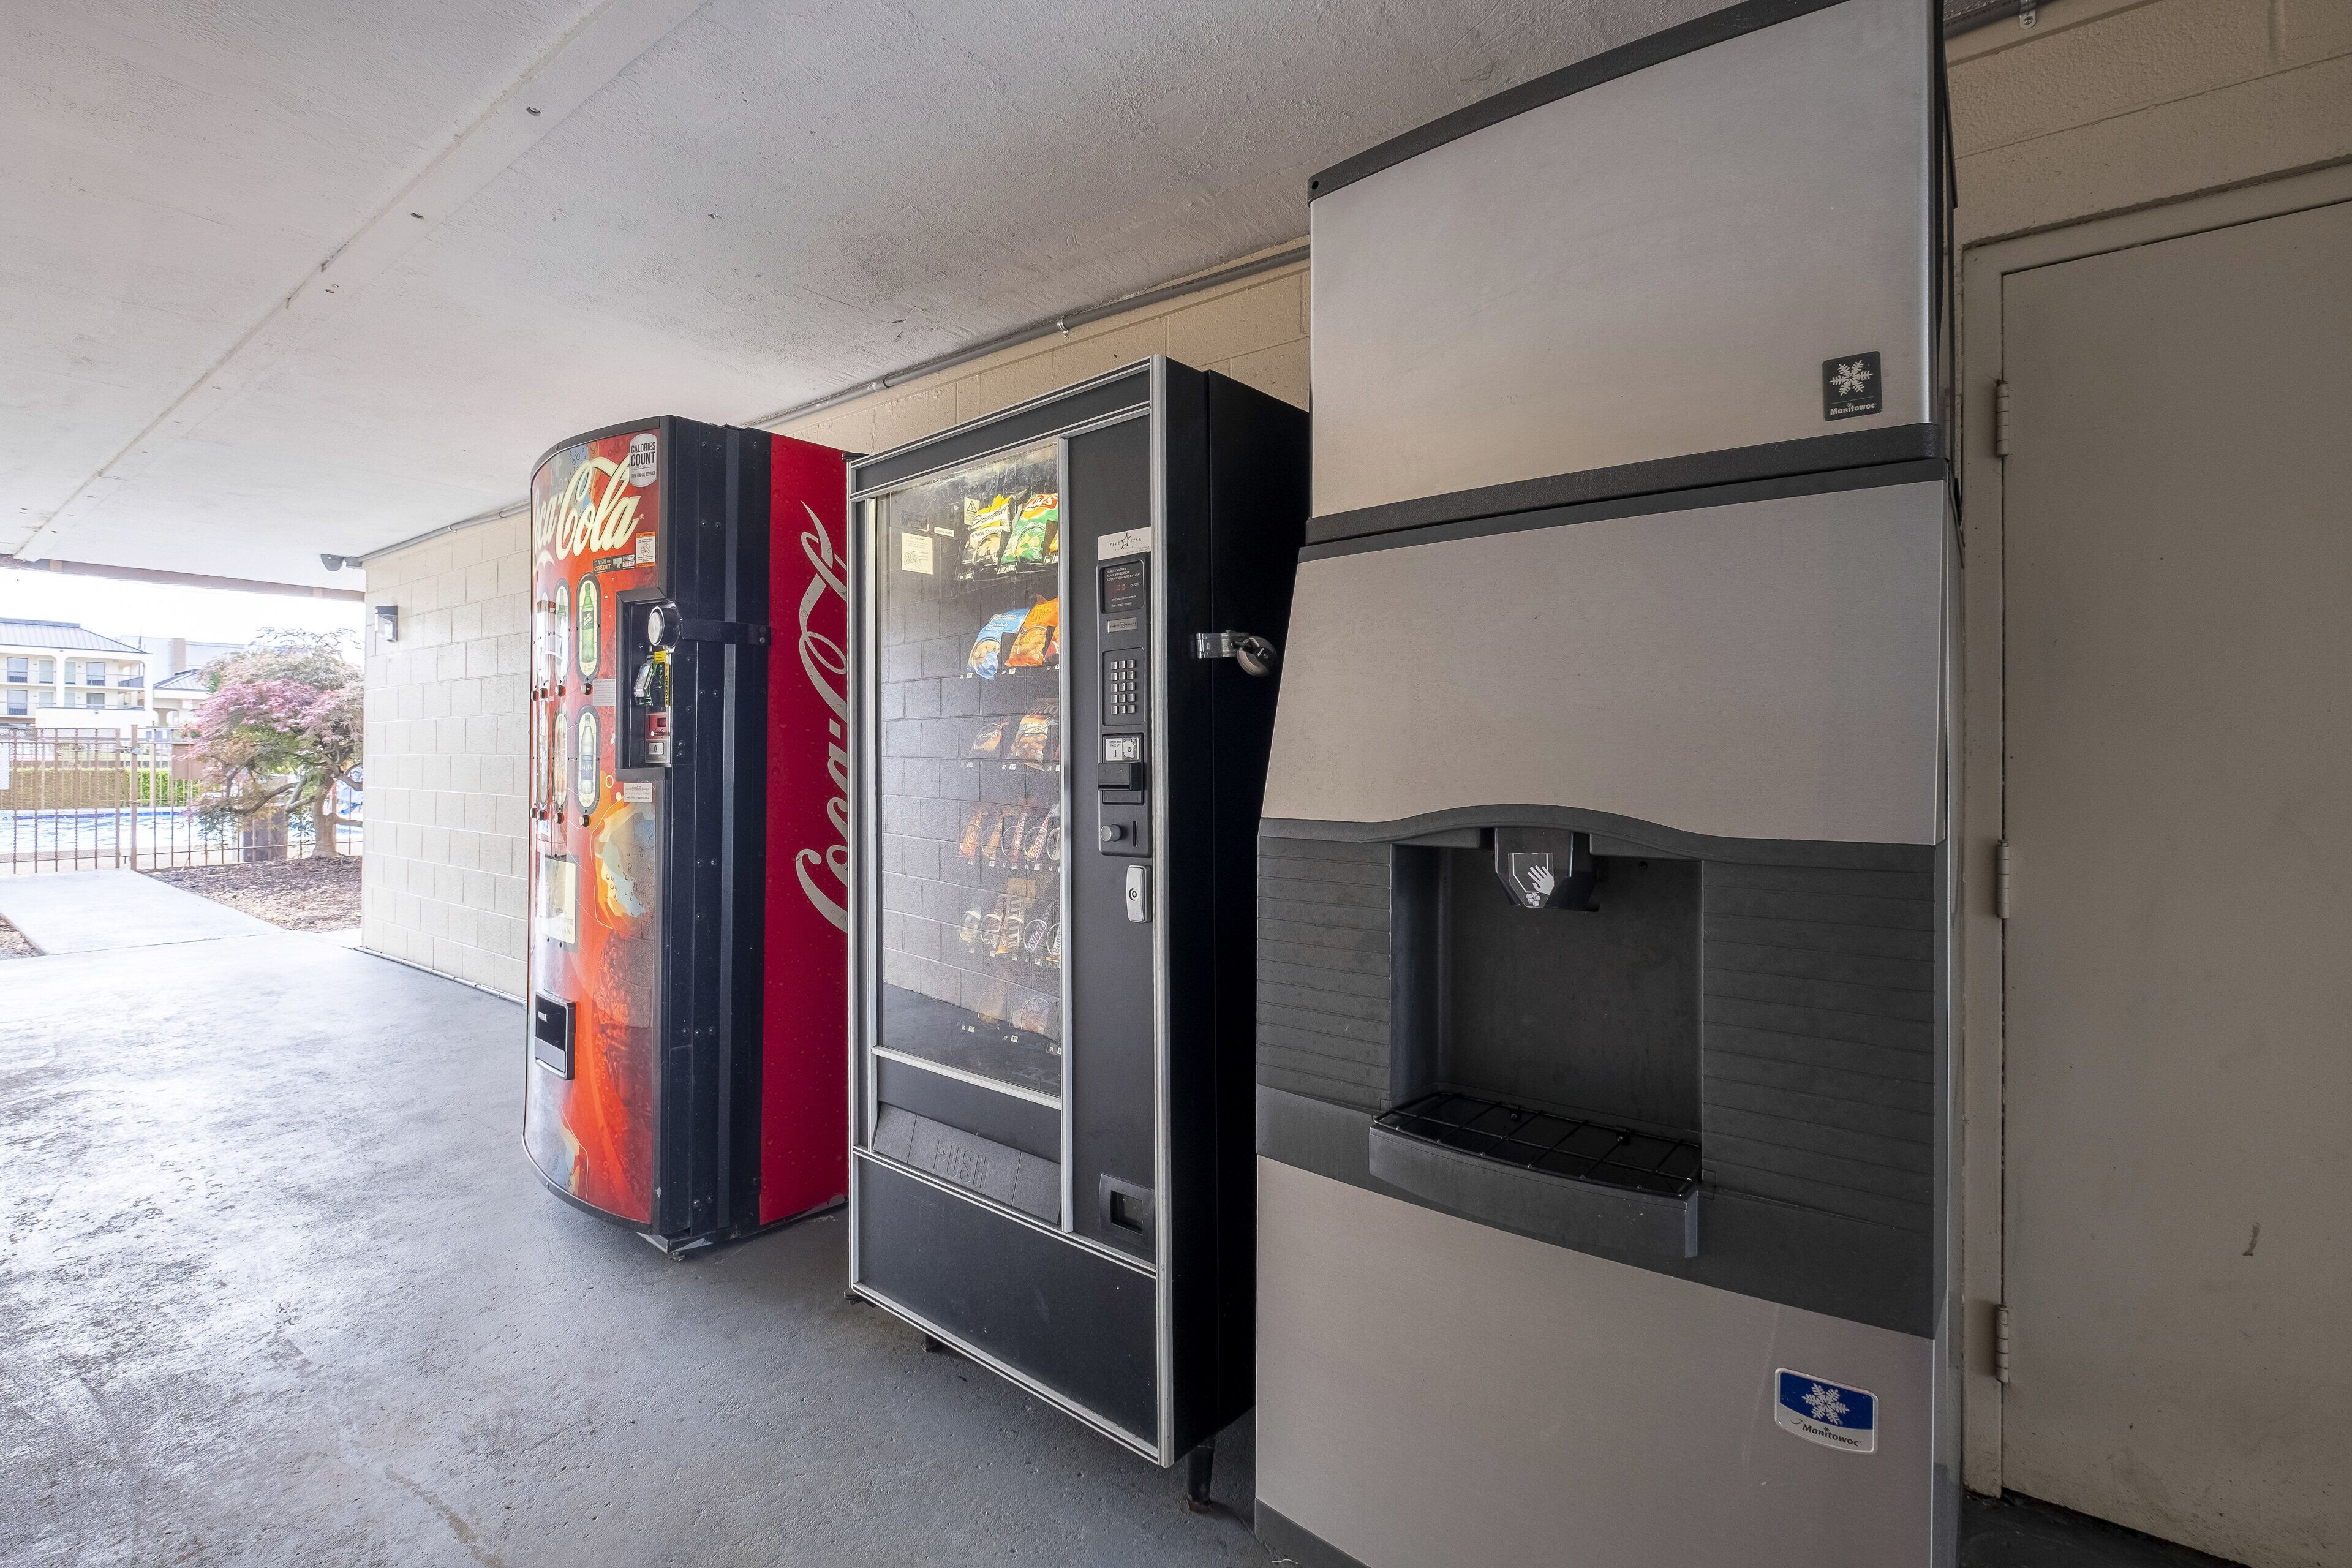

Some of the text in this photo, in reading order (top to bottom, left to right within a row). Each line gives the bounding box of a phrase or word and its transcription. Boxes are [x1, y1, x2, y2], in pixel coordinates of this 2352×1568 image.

[1830, 402, 1875, 415] Manitowoc
[631, 442, 656, 454] CALORIES
[631, 451, 656, 467] COUNT
[932, 1139, 990, 1189] PUSH
[1801, 1423, 1860, 1447] Manitowoc
